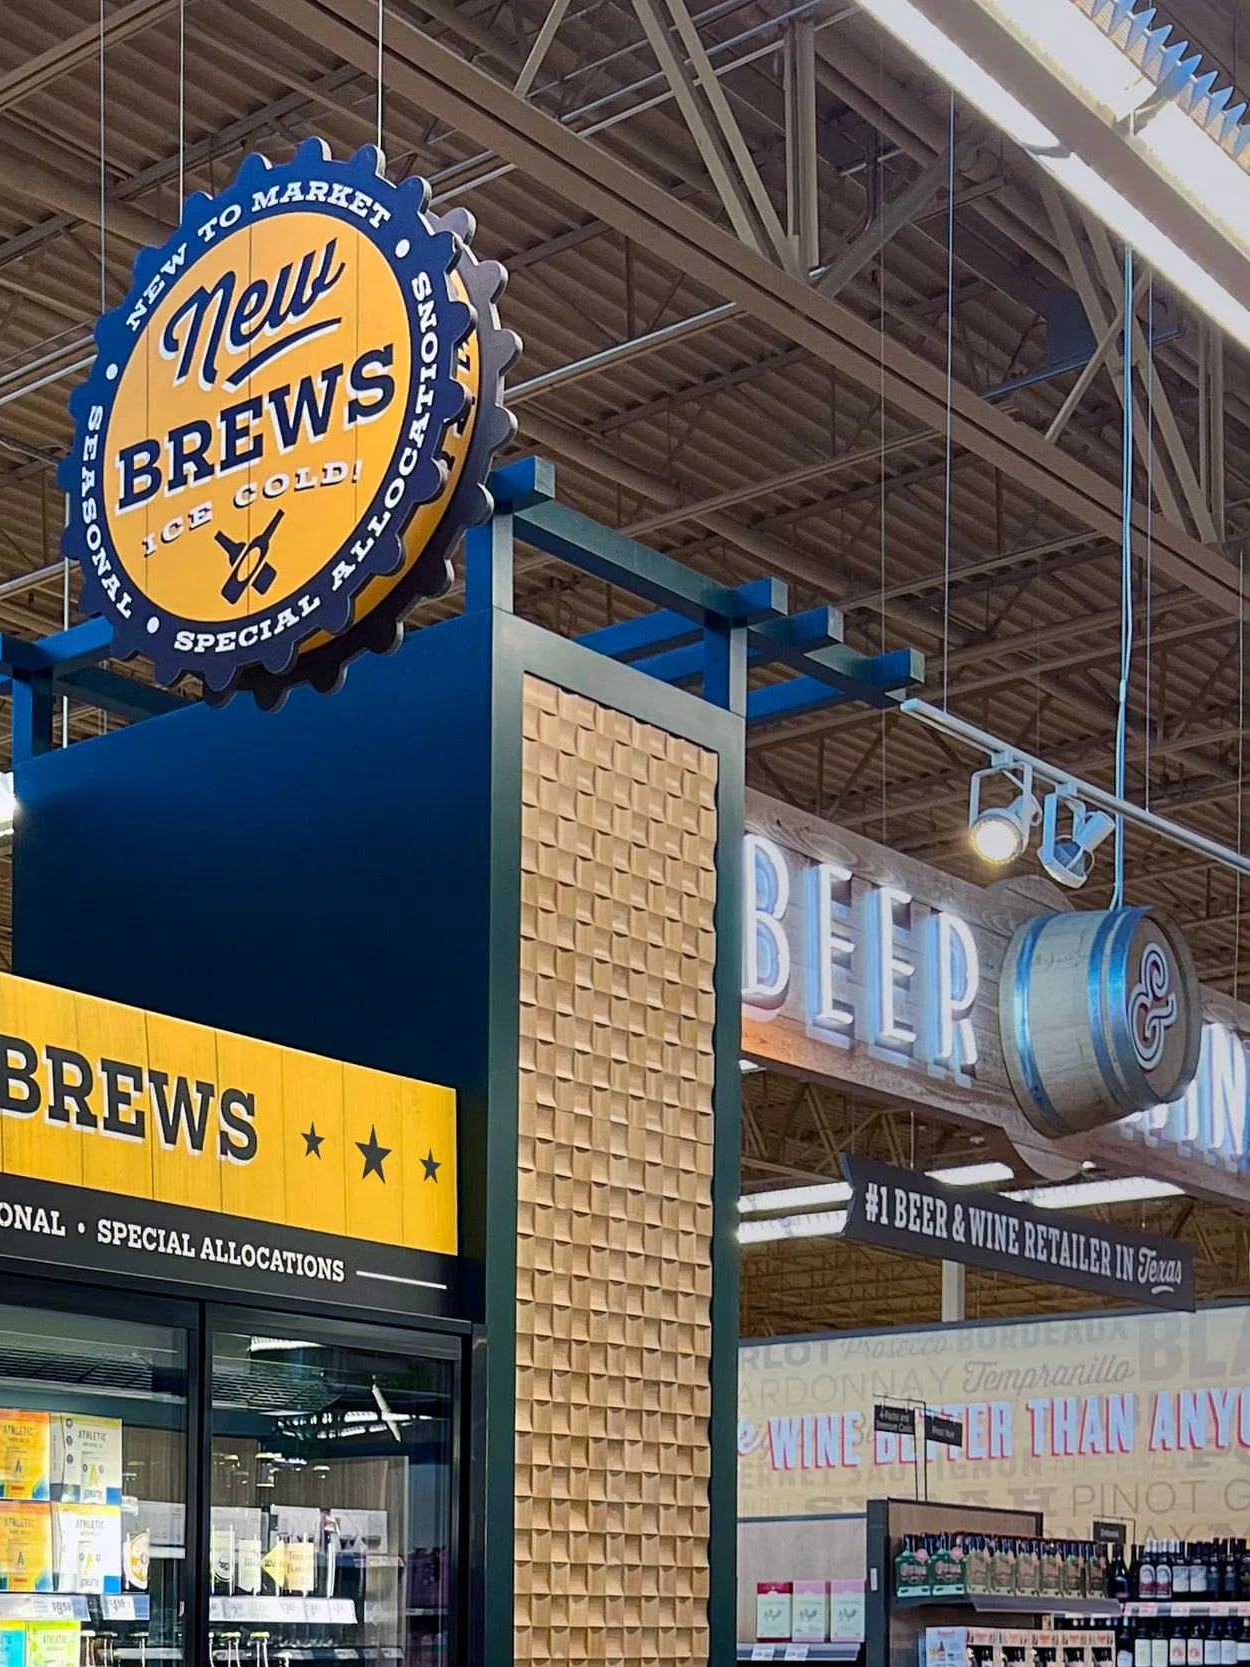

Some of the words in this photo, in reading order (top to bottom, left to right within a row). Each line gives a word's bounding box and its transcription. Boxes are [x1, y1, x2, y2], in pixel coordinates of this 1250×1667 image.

[126, 243, 188, 331] NEW
[198, 204, 242, 243] TO
[251, 181, 392, 228] MARKET
[158, 237, 346, 392] New
[116, 343, 396, 515] BREWS
[174, 595, 321, 653] SPECIAL
[331, 272, 438, 590] ALLOCATIONS
[81, 405, 133, 619] SEASONAL
[142, 501, 212, 558] ICE
[235, 459, 365, 508] COLD!
[742, 834, 979, 1066] BEER
[1129, 942, 1177, 1070] &
[97, 1219, 195, 1258] SPECIAL
[200, 1236, 345, 1283] ALLOCATIONS
[865, 1182, 889, 1223] #1
[894, 1189, 948, 1237] BEER
[953, 1204, 966, 1243] &
[969, 1207, 1019, 1256] WINE
[1024, 1221, 1111, 1275] RETAILER
[1116, 1244, 1133, 1281] IN
[1137, 1248, 1182, 1285] Texas
[963, 1355, 1135, 1397] Tempranillo
[3, 1425, 34, 1437] ATHLETIC
[78, 1428, 107, 1442] ATHLETIC
[768, 1411, 863, 1471] WINE
[1026, 1392, 1134, 1457] THAN
[1073, 1478, 1207, 1516] PINOT
